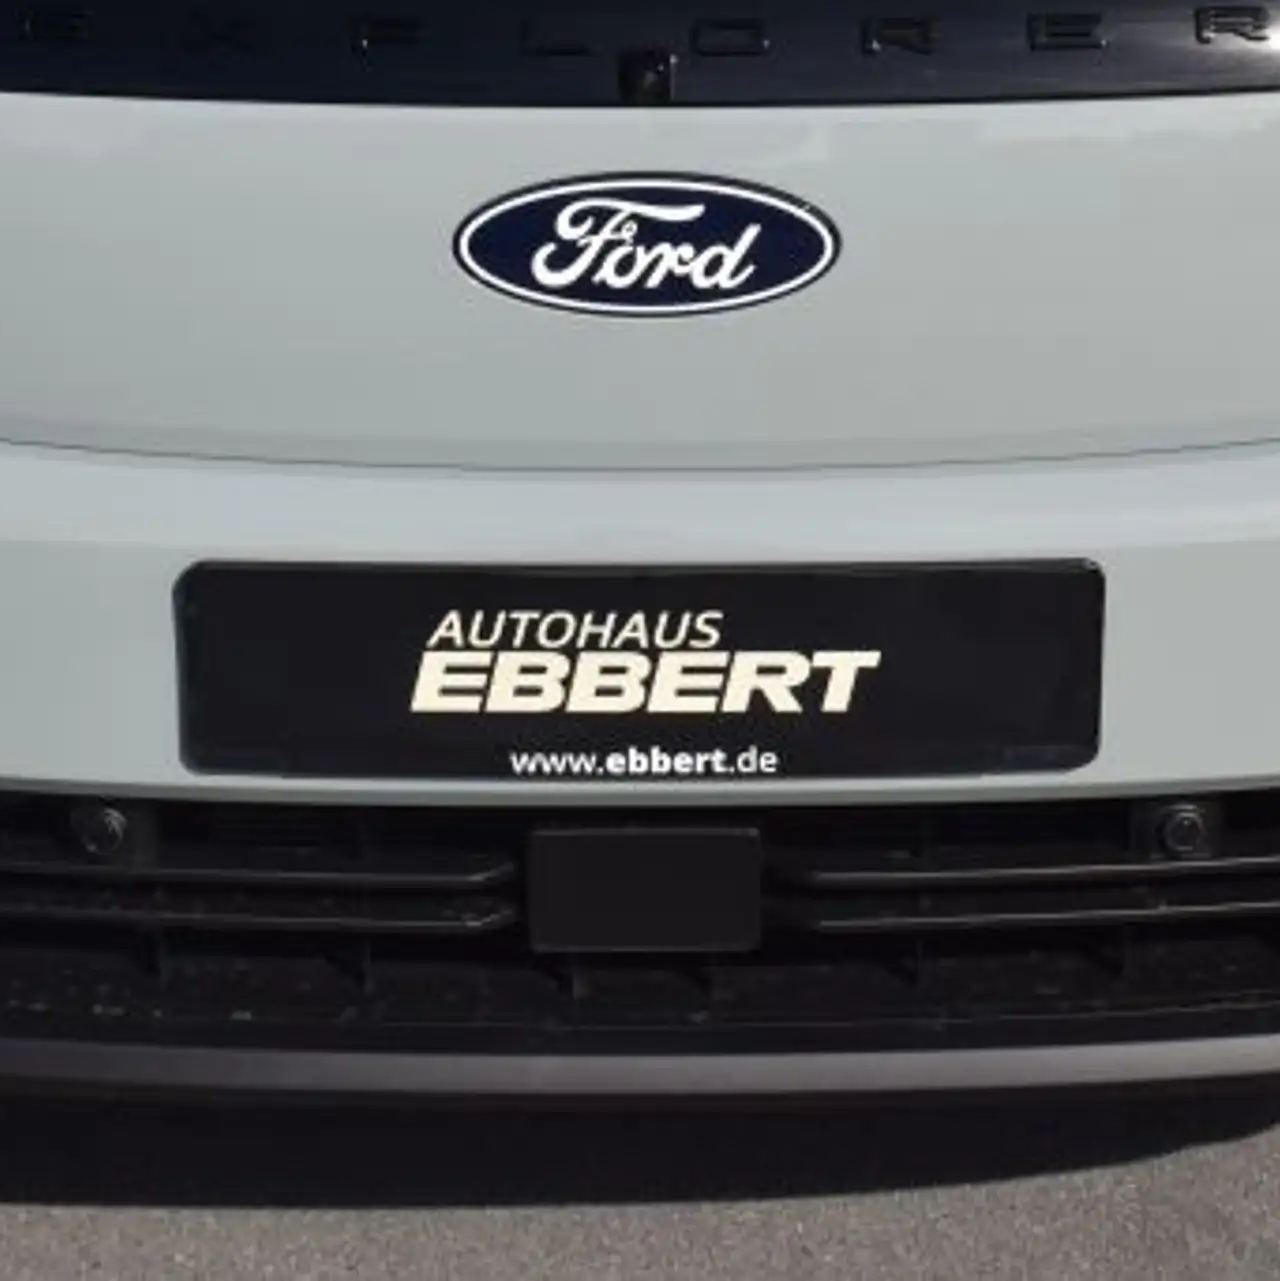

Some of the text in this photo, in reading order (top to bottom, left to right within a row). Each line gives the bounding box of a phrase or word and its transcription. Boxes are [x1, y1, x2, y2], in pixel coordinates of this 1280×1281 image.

[531, 197, 761, 288] Ford
[426, 610, 724, 648] AUTOHAUS
[410, 650, 882, 713] EBBERT
[509, 745, 779, 775] www.ebbert.de
